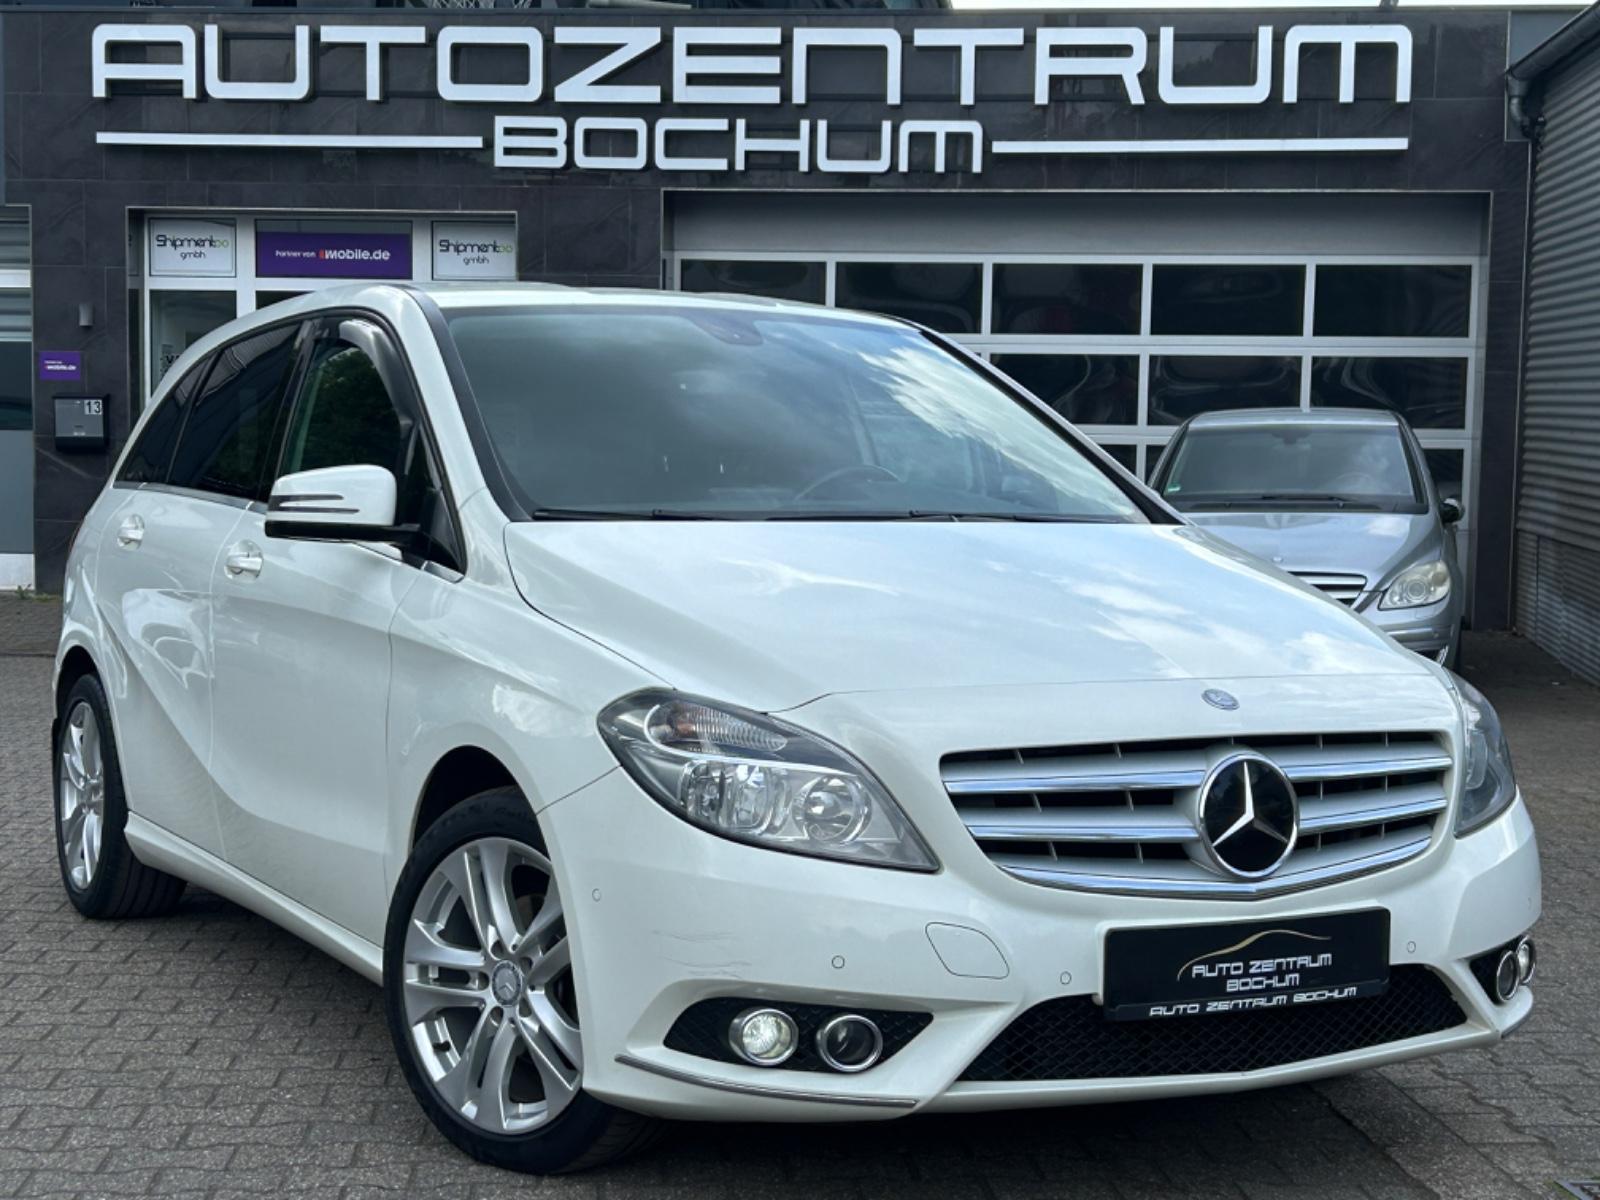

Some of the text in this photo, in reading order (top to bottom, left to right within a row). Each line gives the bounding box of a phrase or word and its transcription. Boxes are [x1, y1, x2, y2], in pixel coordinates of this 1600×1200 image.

[92, 24, 1413, 106] AUTOZENTRUM
[493, 115, 984, 174] BOCHUM
[302, 250, 316, 258] von
[86, 401, 101, 414] 13
[1192, 953, 1332, 979] AUTO ZENTRUM
[1226, 973, 1300, 993] BOCHUM
[1149, 986, 1358, 1017] AUTO ZENTRUM BOCHUM
